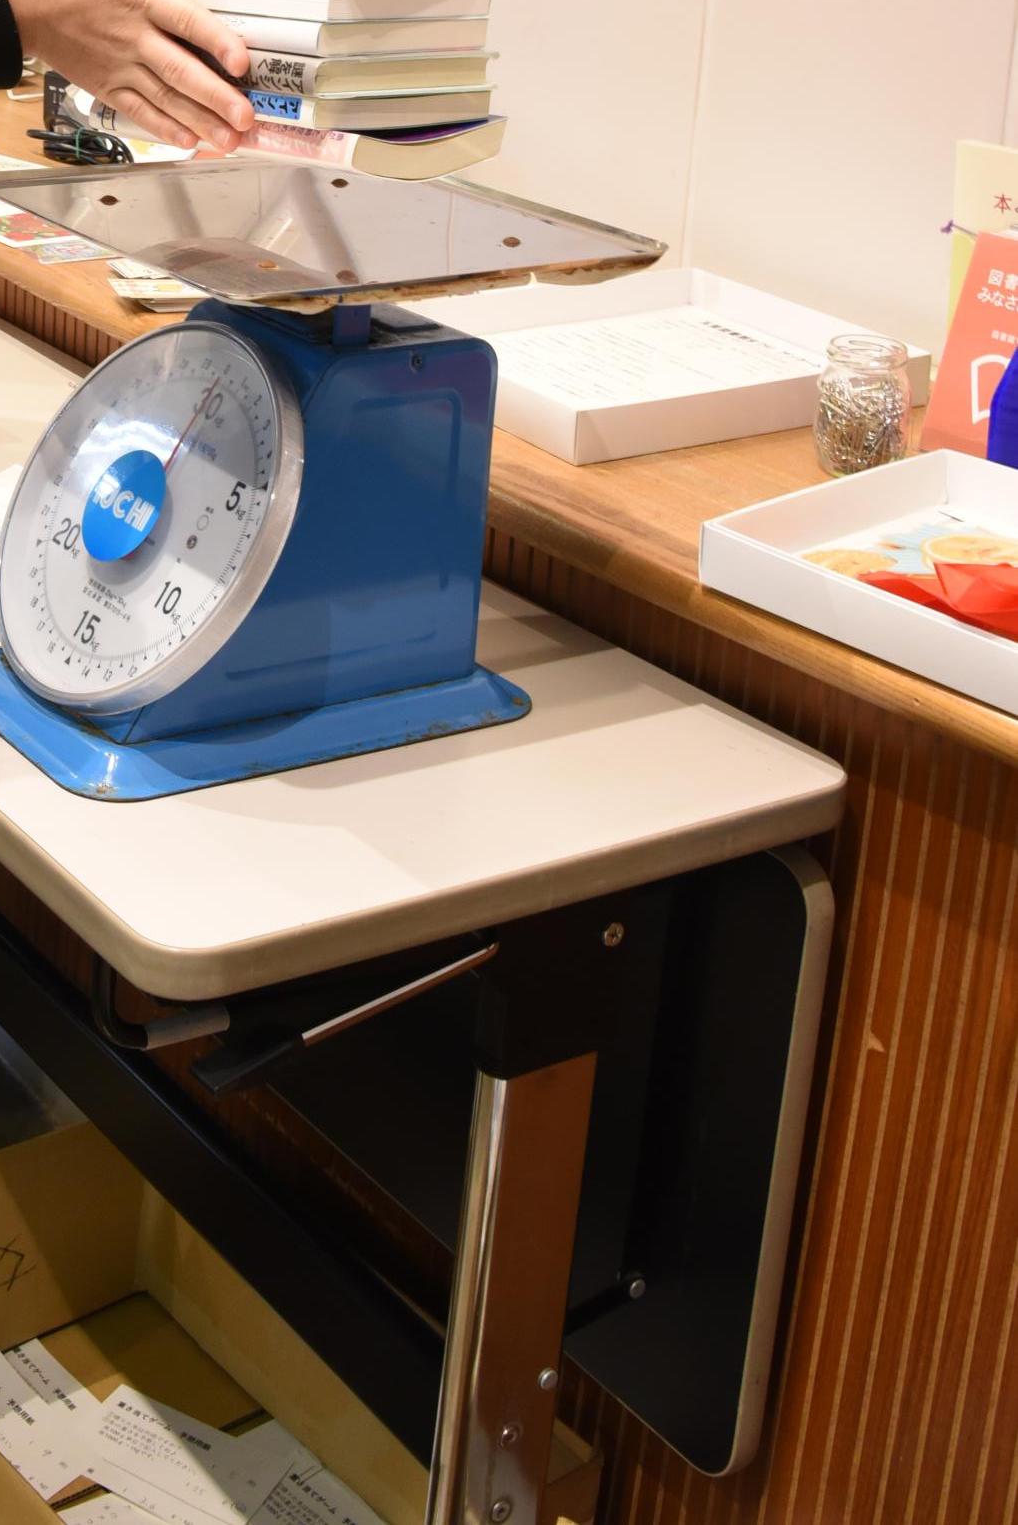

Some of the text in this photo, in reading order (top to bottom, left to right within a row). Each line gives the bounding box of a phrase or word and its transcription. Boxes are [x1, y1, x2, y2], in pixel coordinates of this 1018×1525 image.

[994, 194, 1018, 214] 本
[977, 287, 1018, 312] みなさ
